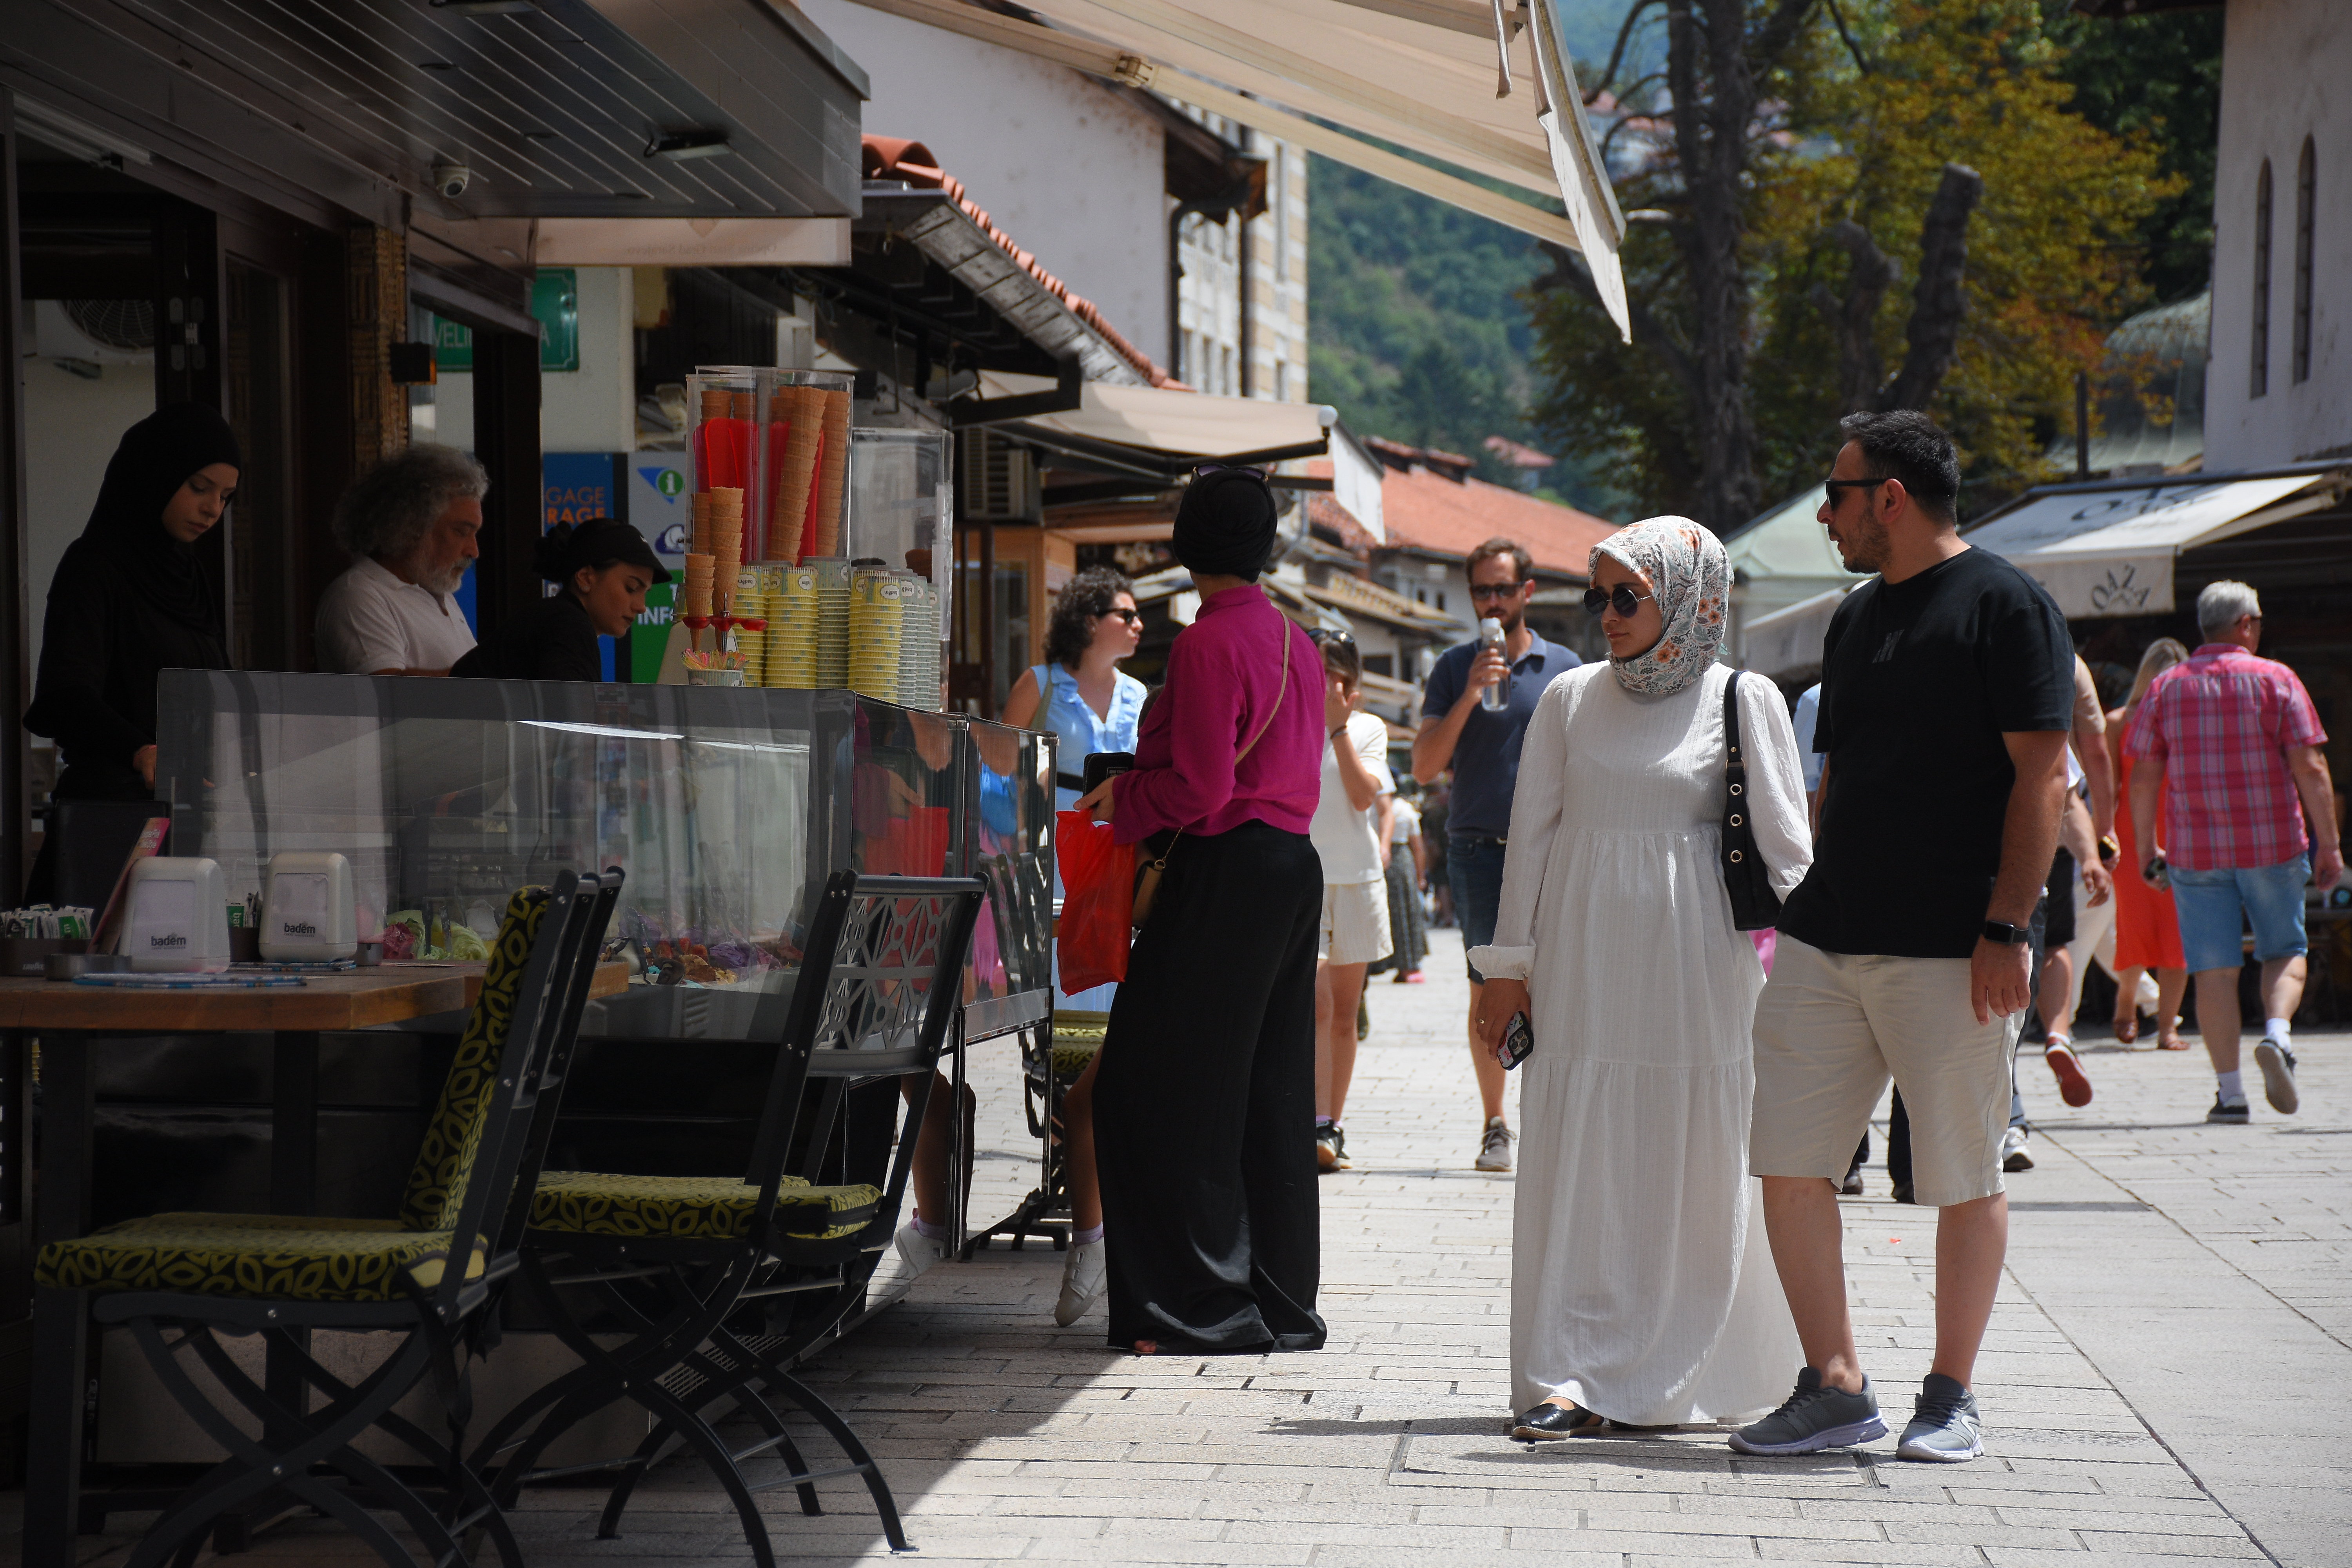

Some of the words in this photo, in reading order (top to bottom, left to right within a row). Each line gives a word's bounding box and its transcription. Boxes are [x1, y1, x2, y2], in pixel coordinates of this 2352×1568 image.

[546, 486, 604, 505] GAGE
[547, 507, 605, 524] RAGE
[638, 606, 673, 625] INF
